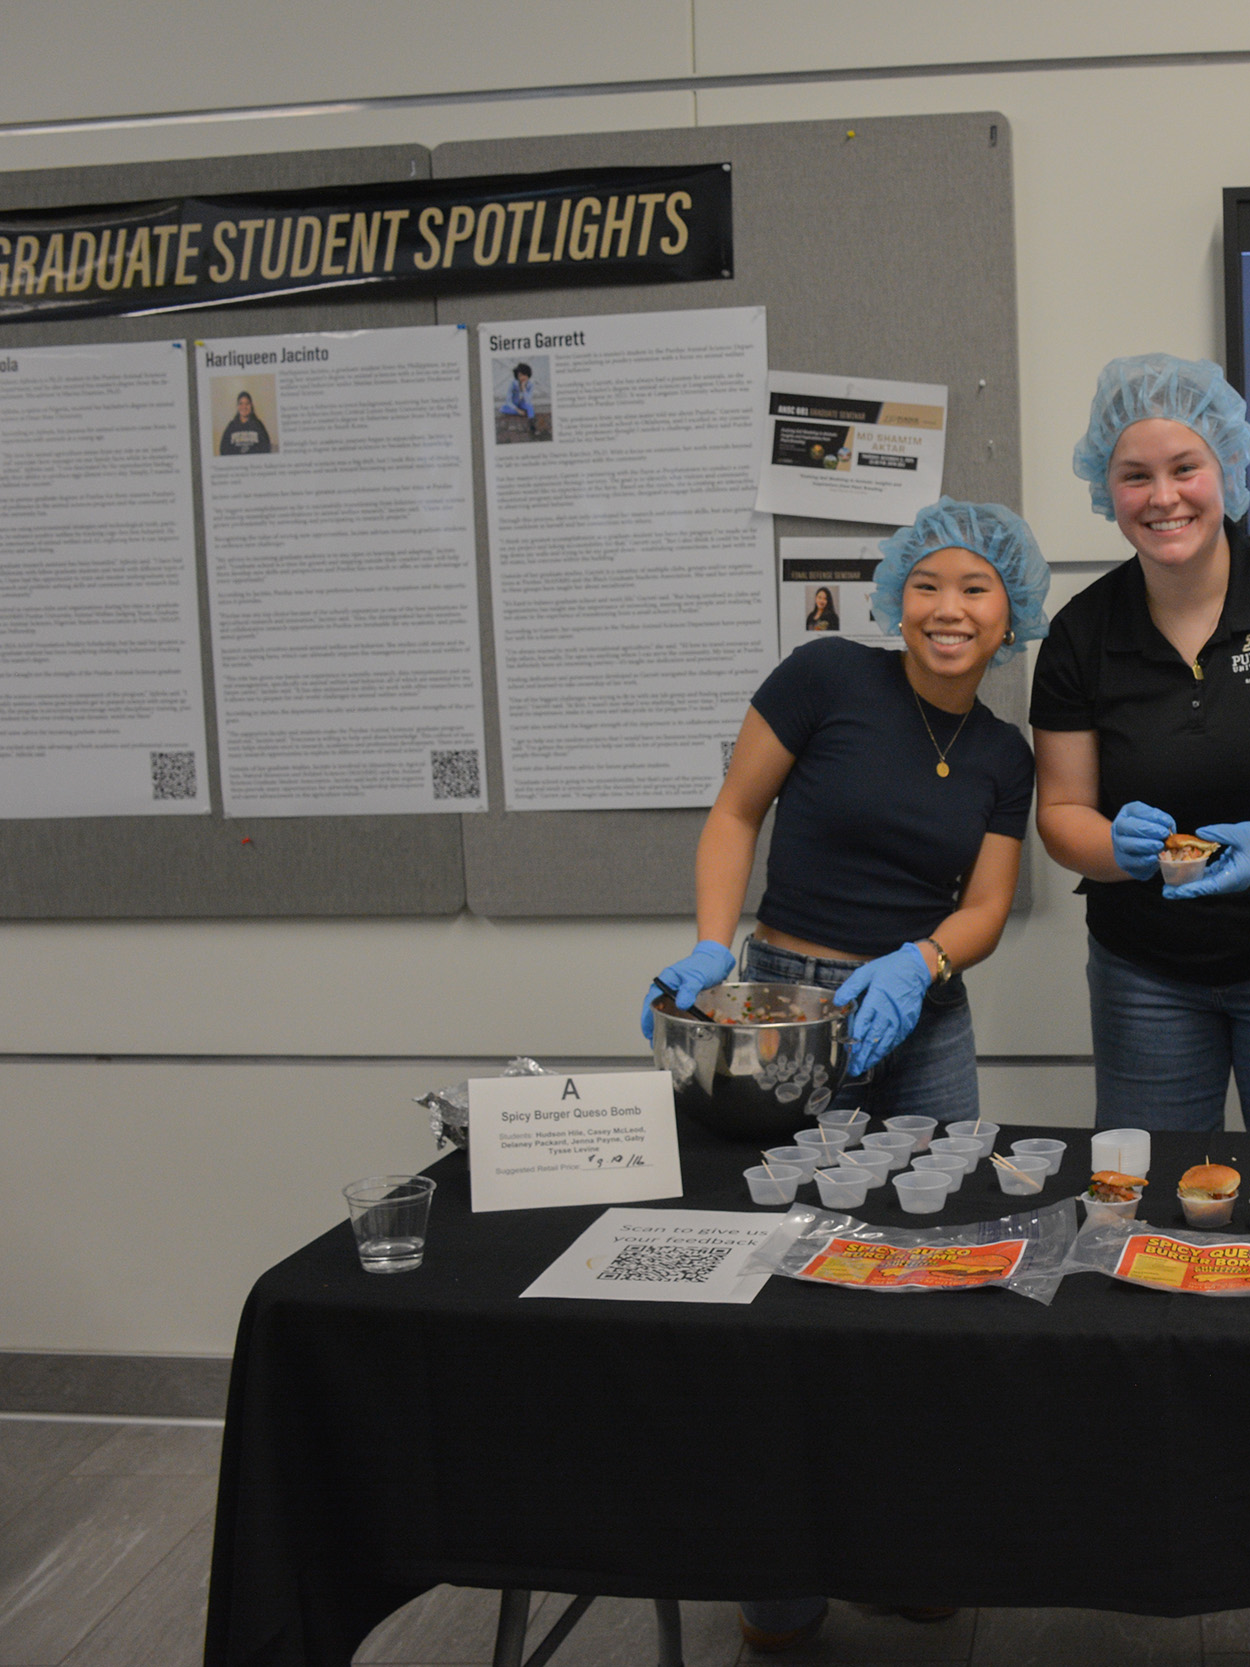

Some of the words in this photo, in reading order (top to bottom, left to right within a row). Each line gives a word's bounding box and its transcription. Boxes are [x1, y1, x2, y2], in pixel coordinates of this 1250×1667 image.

[0, 224, 201, 297] GRADUATE
[210, 209, 409, 284] STUDENT
[414, 190, 693, 268] SPOTLIGHTS
[489, 333, 531, 352] Sierra
[534, 330, 586, 350] Garrett
[205, 349, 278, 370] Harliqueen
[280, 345, 329, 365] Jacinto
[561, 1078, 581, 1101] A
[501, 1110, 531, 1123] Spicy
[534, 1108, 570, 1122] Burger
[573, 1107, 608, 1119] Queso
[610, 1105, 642, 1116] Bomb
[501, 1141, 533, 1149] Delaney
[496, 1167, 535, 1175] Suggested
[619, 1224, 666, 1233] Scan
[673, 1226, 693, 1234] to
[697, 1226, 740, 1236] give
[612, 1236, 662, 1245] your
[665, 1235, 759, 1247] feedback
[1147, 1238, 1204, 1257] SPICY
[845, 1243, 900, 1258] SPICY
[1144, 1245, 1212, 1266] BURGER
